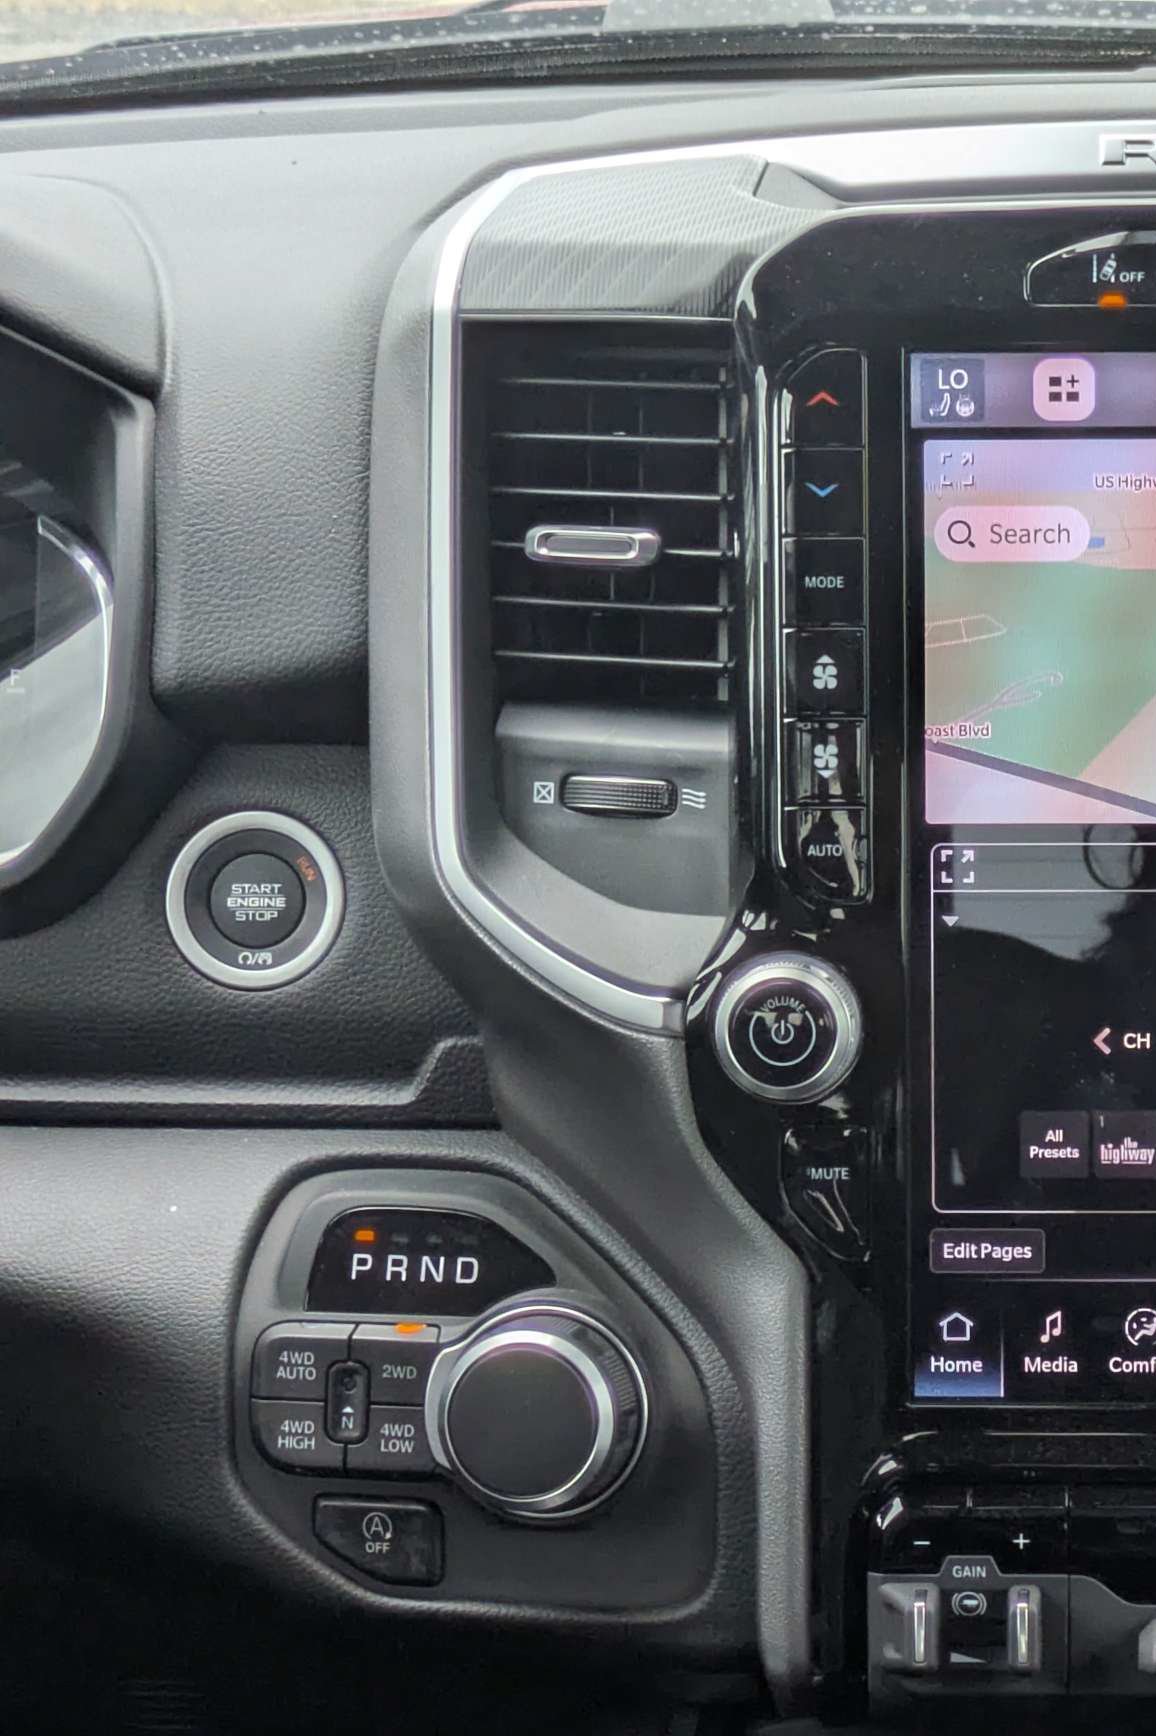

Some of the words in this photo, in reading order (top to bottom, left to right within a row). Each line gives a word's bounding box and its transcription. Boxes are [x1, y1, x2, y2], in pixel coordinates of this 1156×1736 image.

[1120, 271, 1145, 283] OFF
[938, 368, 969, 390] LO
[1095, 475, 1115, 489] US
[990, 523, 1072, 545] Search
[805, 575, 845, 589] MODE
[959, 724, 990, 737] Blvd
[807, 844, 842, 857] AUTO
[231, 883, 283, 894] START
[226, 897, 288, 908] ENGINE
[235, 910, 278, 921] STOP
[760, 996, 806, 1012] VOLUME
[1123, 1033, 1150, 1049] CH
[1045, 1130, 1063, 1142] All
[1030, 1146, 1080, 1159] Presets
[1100, 1143, 1155, 1164] highway
[811, 1167, 849, 1180] MUTE
[943, 1244, 978, 1259] Edit
[981, 1244, 1032, 1261] Pages
[351, 1253, 373, 1281] P
[386, 1255, 408, 1282] R
[420, 1256, 445, 1283] N
[455, 1257, 479, 1284] D
[279, 1351, 315, 1365] 4WD
[930, 1356, 983, 1373] Home
[1024, 1356, 1078, 1373] Media
[276, 1367, 317, 1380] AUTO
[382, 1365, 417, 1379] 2WD
[280, 1420, 315, 1434] 4WD
[341, 1416, 354, 1429] N
[380, 1424, 415, 1437] 4WD
[277, 1436, 316, 1450] HIGH
[380, 1440, 415, 1453] LOW
[365, 1542, 391, 1553] OFF
[952, 1565, 987, 1578] GAIN
